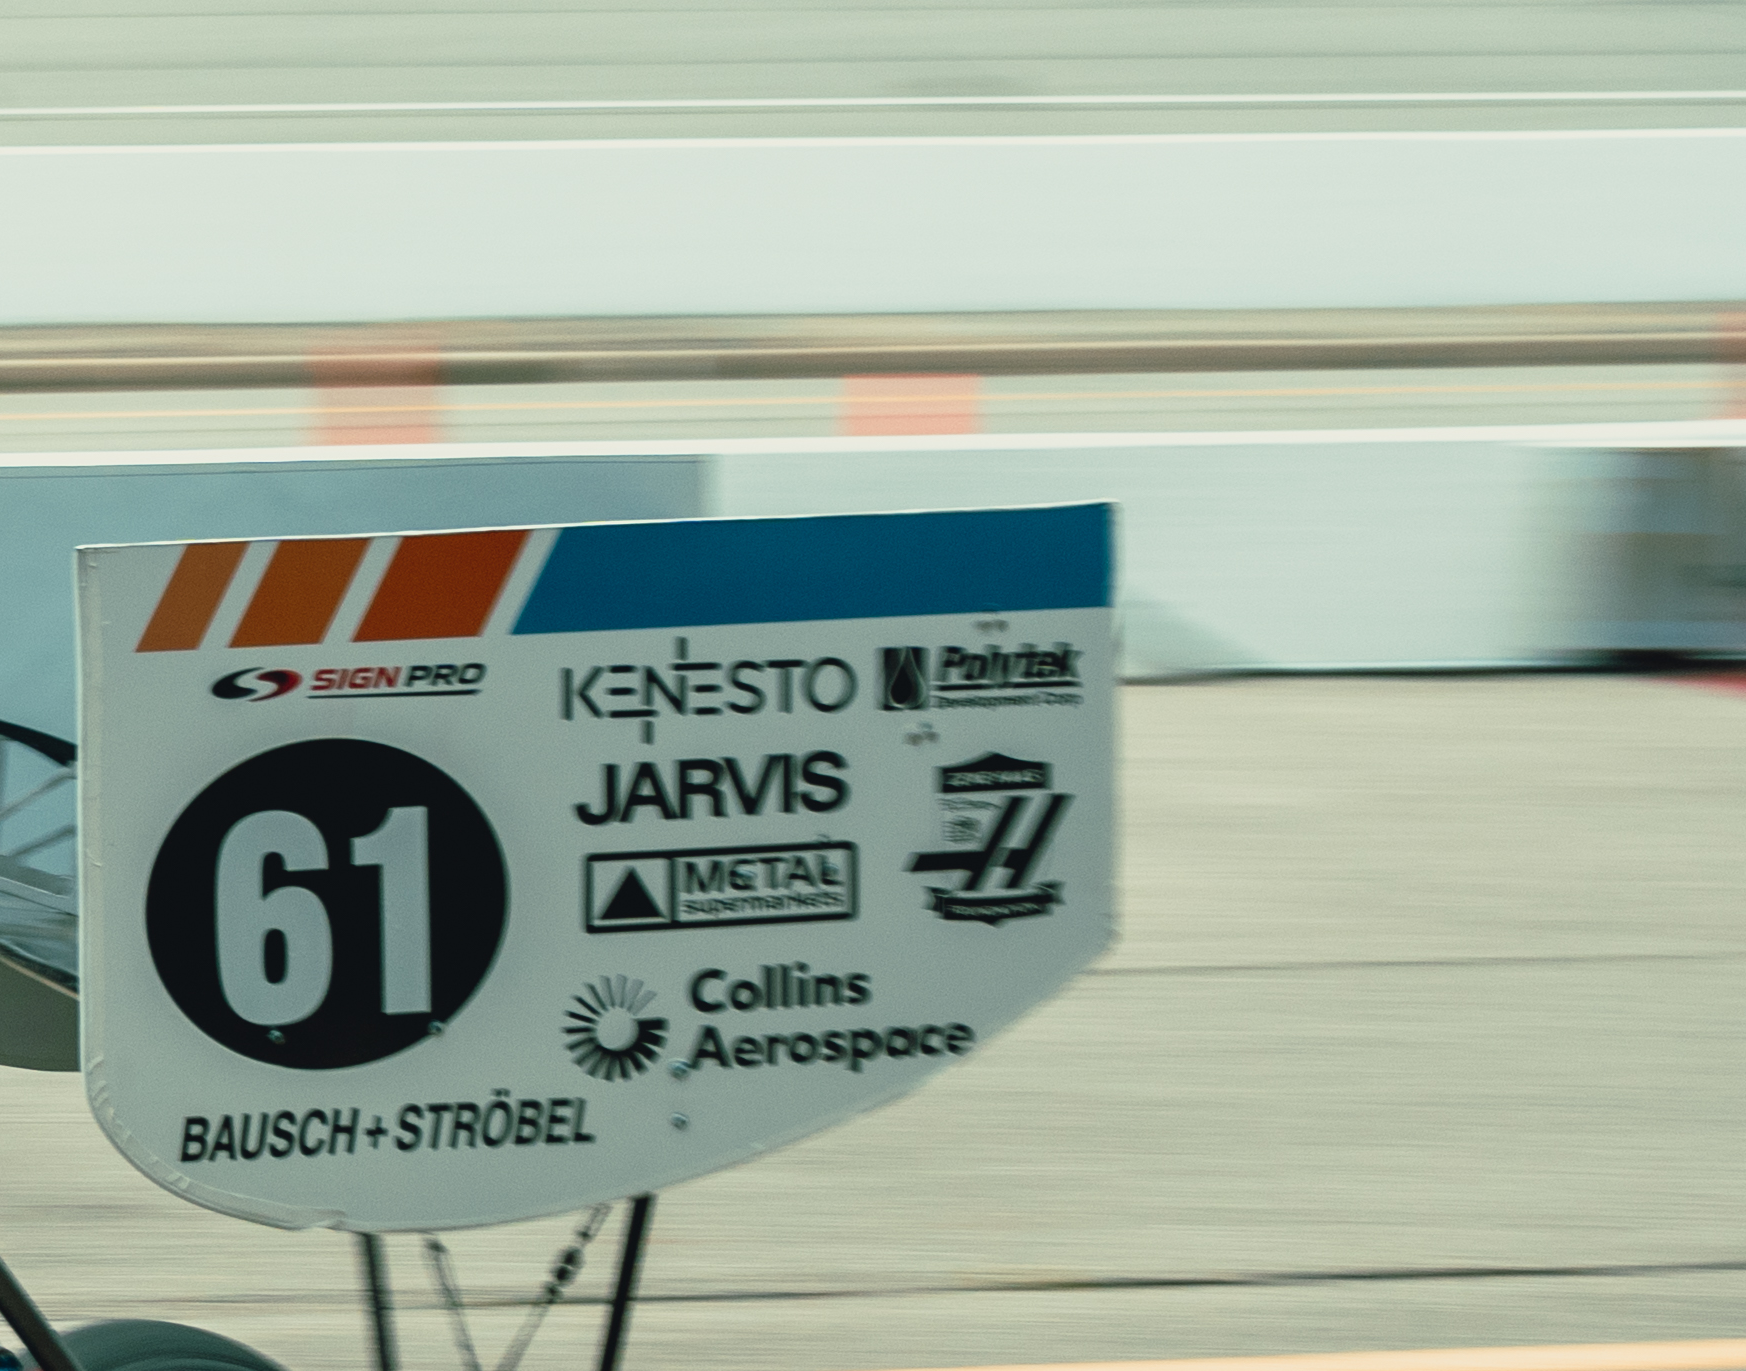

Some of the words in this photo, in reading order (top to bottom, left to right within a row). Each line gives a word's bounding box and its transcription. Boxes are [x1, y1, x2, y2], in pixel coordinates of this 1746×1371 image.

[312, 665, 402, 692] SIGN
[404, 661, 488, 688] PRO
[560, 637, 860, 744] KENESTO
[574, 750, 852, 826] JARVIS
[680, 853, 846, 894] METAL
[215, 805, 433, 1027] 61
[687, 961, 874, 1014] Collins
[689, 1021, 976, 1073] Aerospace
